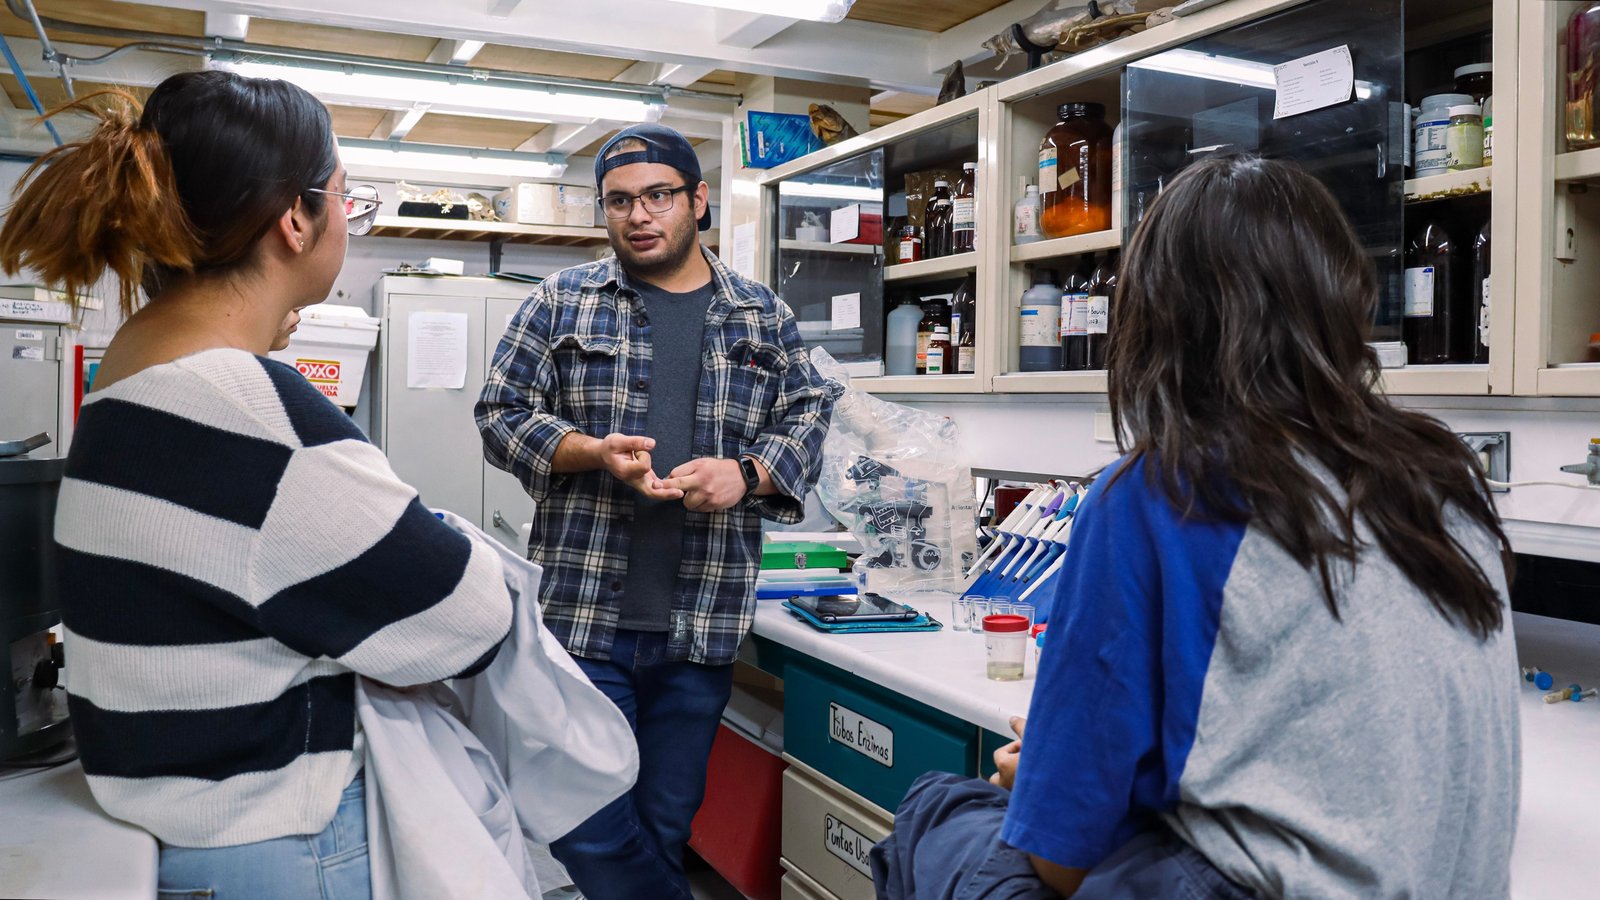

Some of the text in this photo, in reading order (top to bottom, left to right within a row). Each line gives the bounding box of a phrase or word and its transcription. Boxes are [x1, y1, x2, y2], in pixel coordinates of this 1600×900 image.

[298, 363, 339, 379] OXXO
[830, 704, 889, 761] Tubos Enzimas
[826, 817, 870, 866] Puntas Usa
